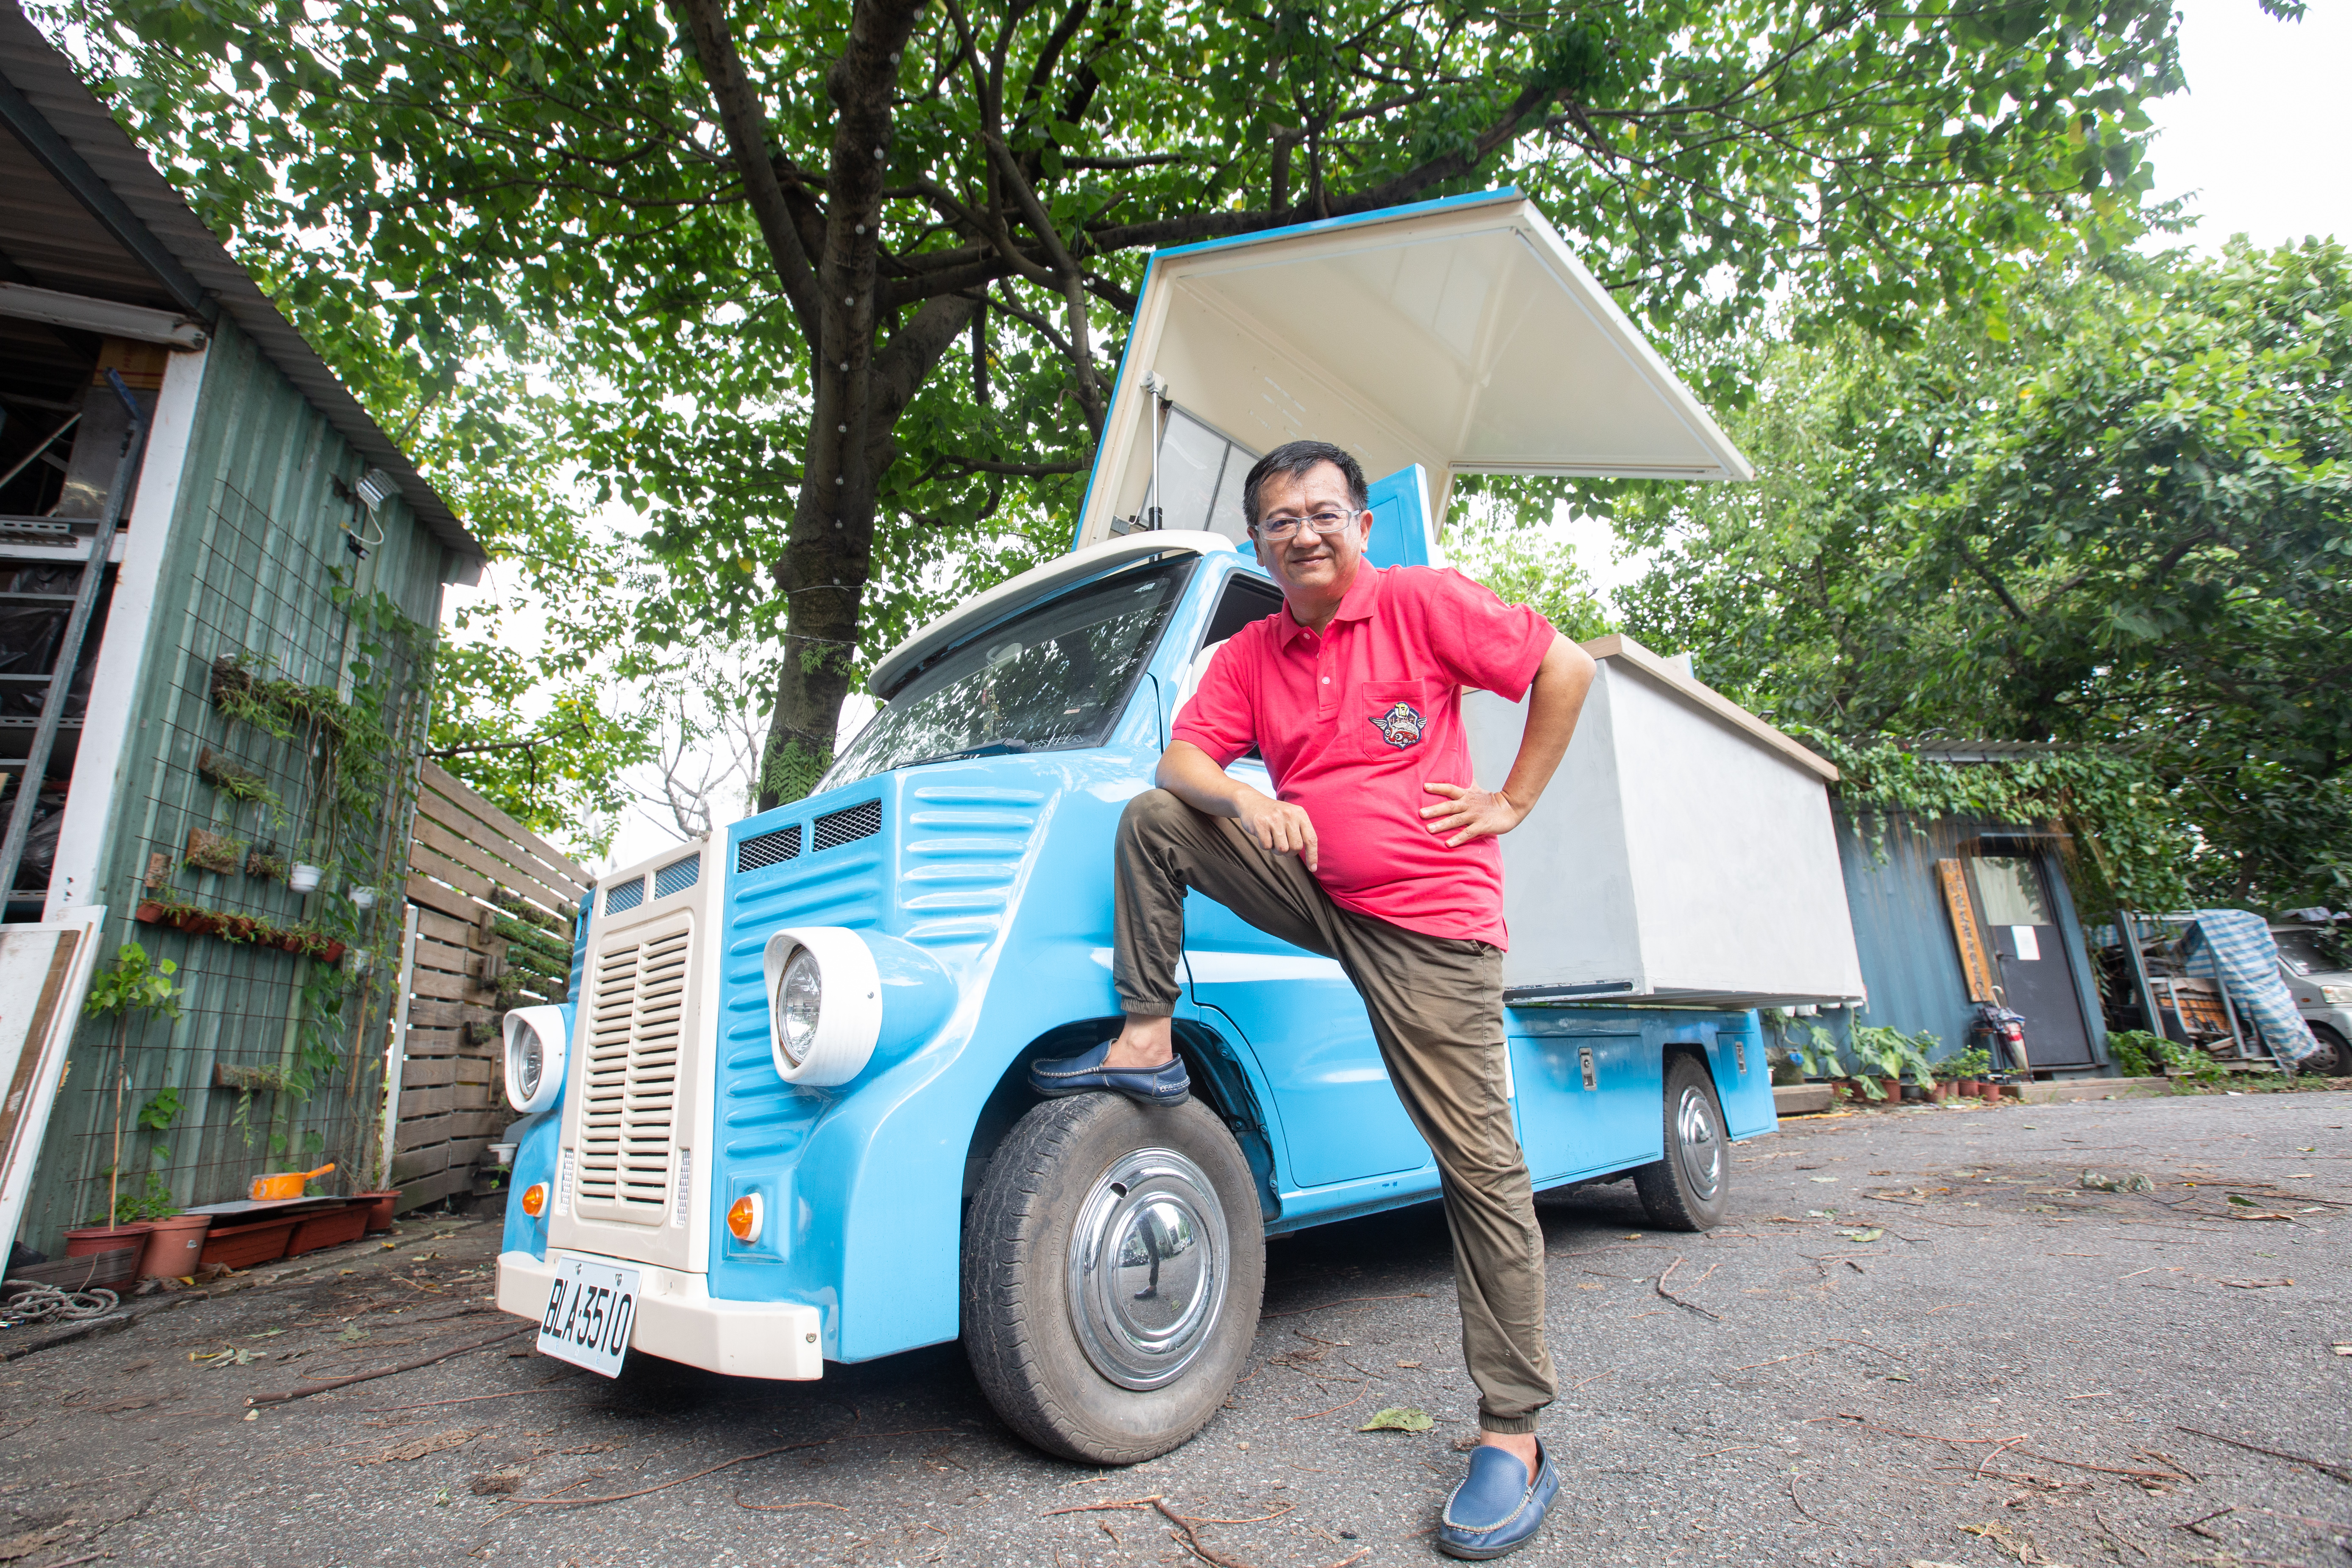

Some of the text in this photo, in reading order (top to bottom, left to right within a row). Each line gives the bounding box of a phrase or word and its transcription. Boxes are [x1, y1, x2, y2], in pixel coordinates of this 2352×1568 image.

[1075, 1131, 1124, 1185] RADIAL LIGHT TRUCK
[1199, 1137, 1248, 1230] 165R13C
[1048, 1201, 1069, 1279] SHIN
[1049, 1298, 1088, 1393] CHENG
